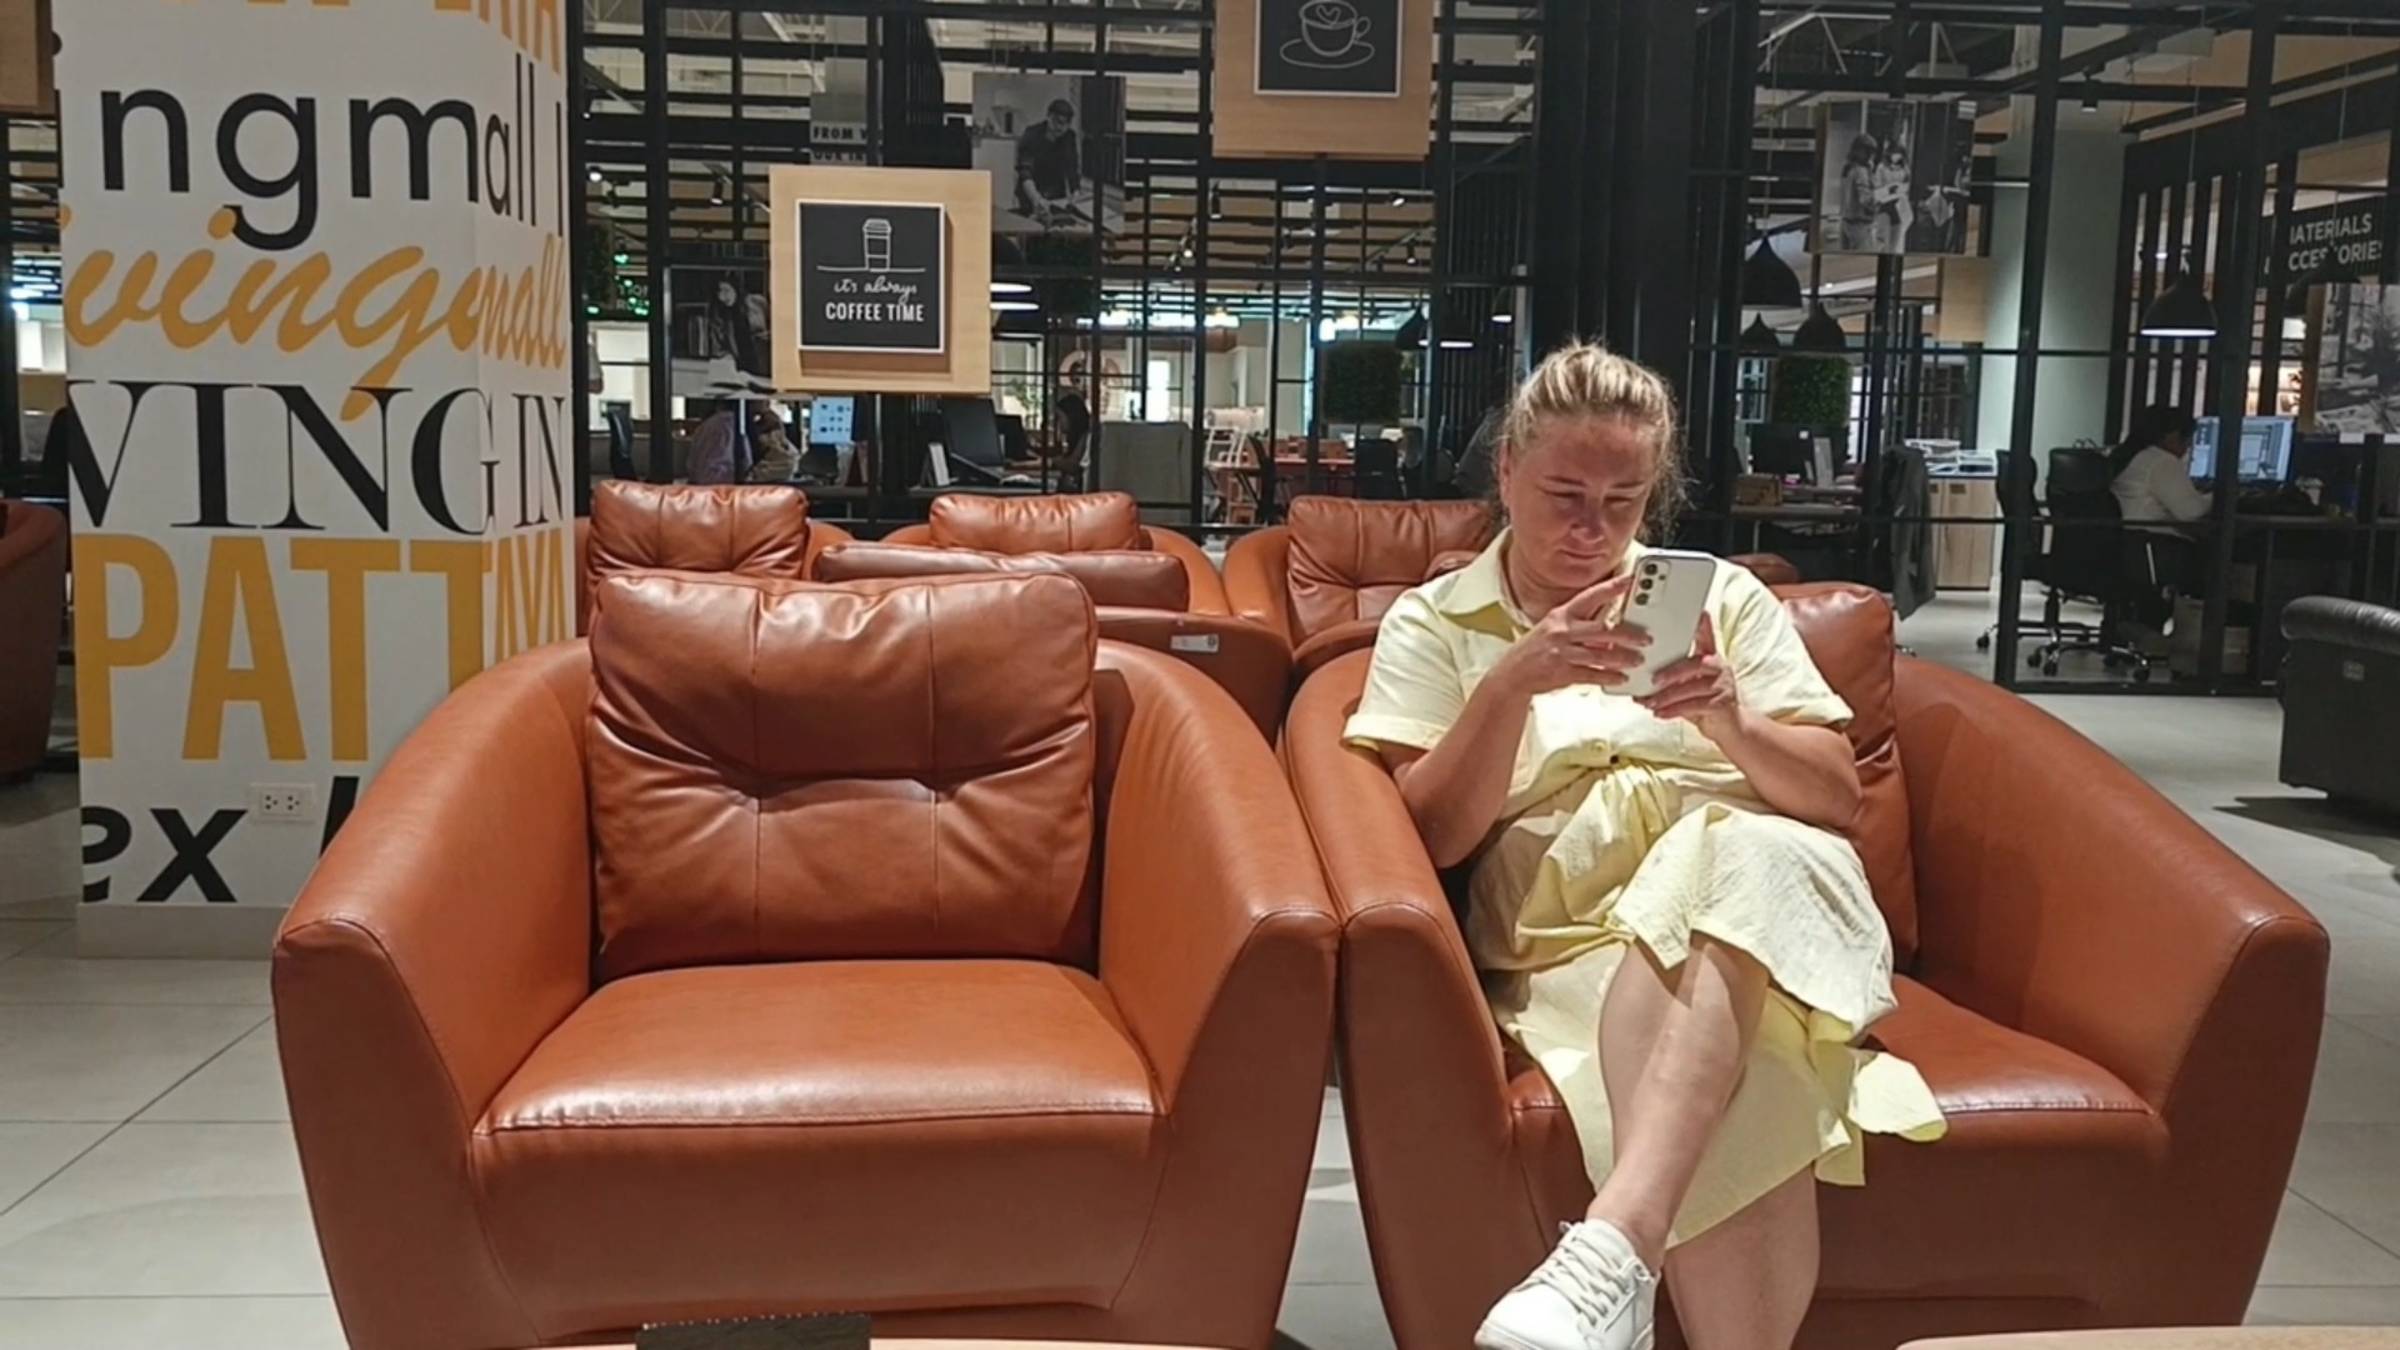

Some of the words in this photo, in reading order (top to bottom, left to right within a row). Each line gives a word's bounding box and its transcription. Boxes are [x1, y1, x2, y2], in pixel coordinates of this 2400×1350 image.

[814, 126, 853, 140] FROM
[2289, 213, 2373, 245] ATERIALS
[864, 275, 917, 305] always
[59, 204, 566, 422] vingmall
[825, 301, 882, 321] COFFEE
[887, 303, 925, 322] TIME
[71, 527, 567, 761] PATTAYA
